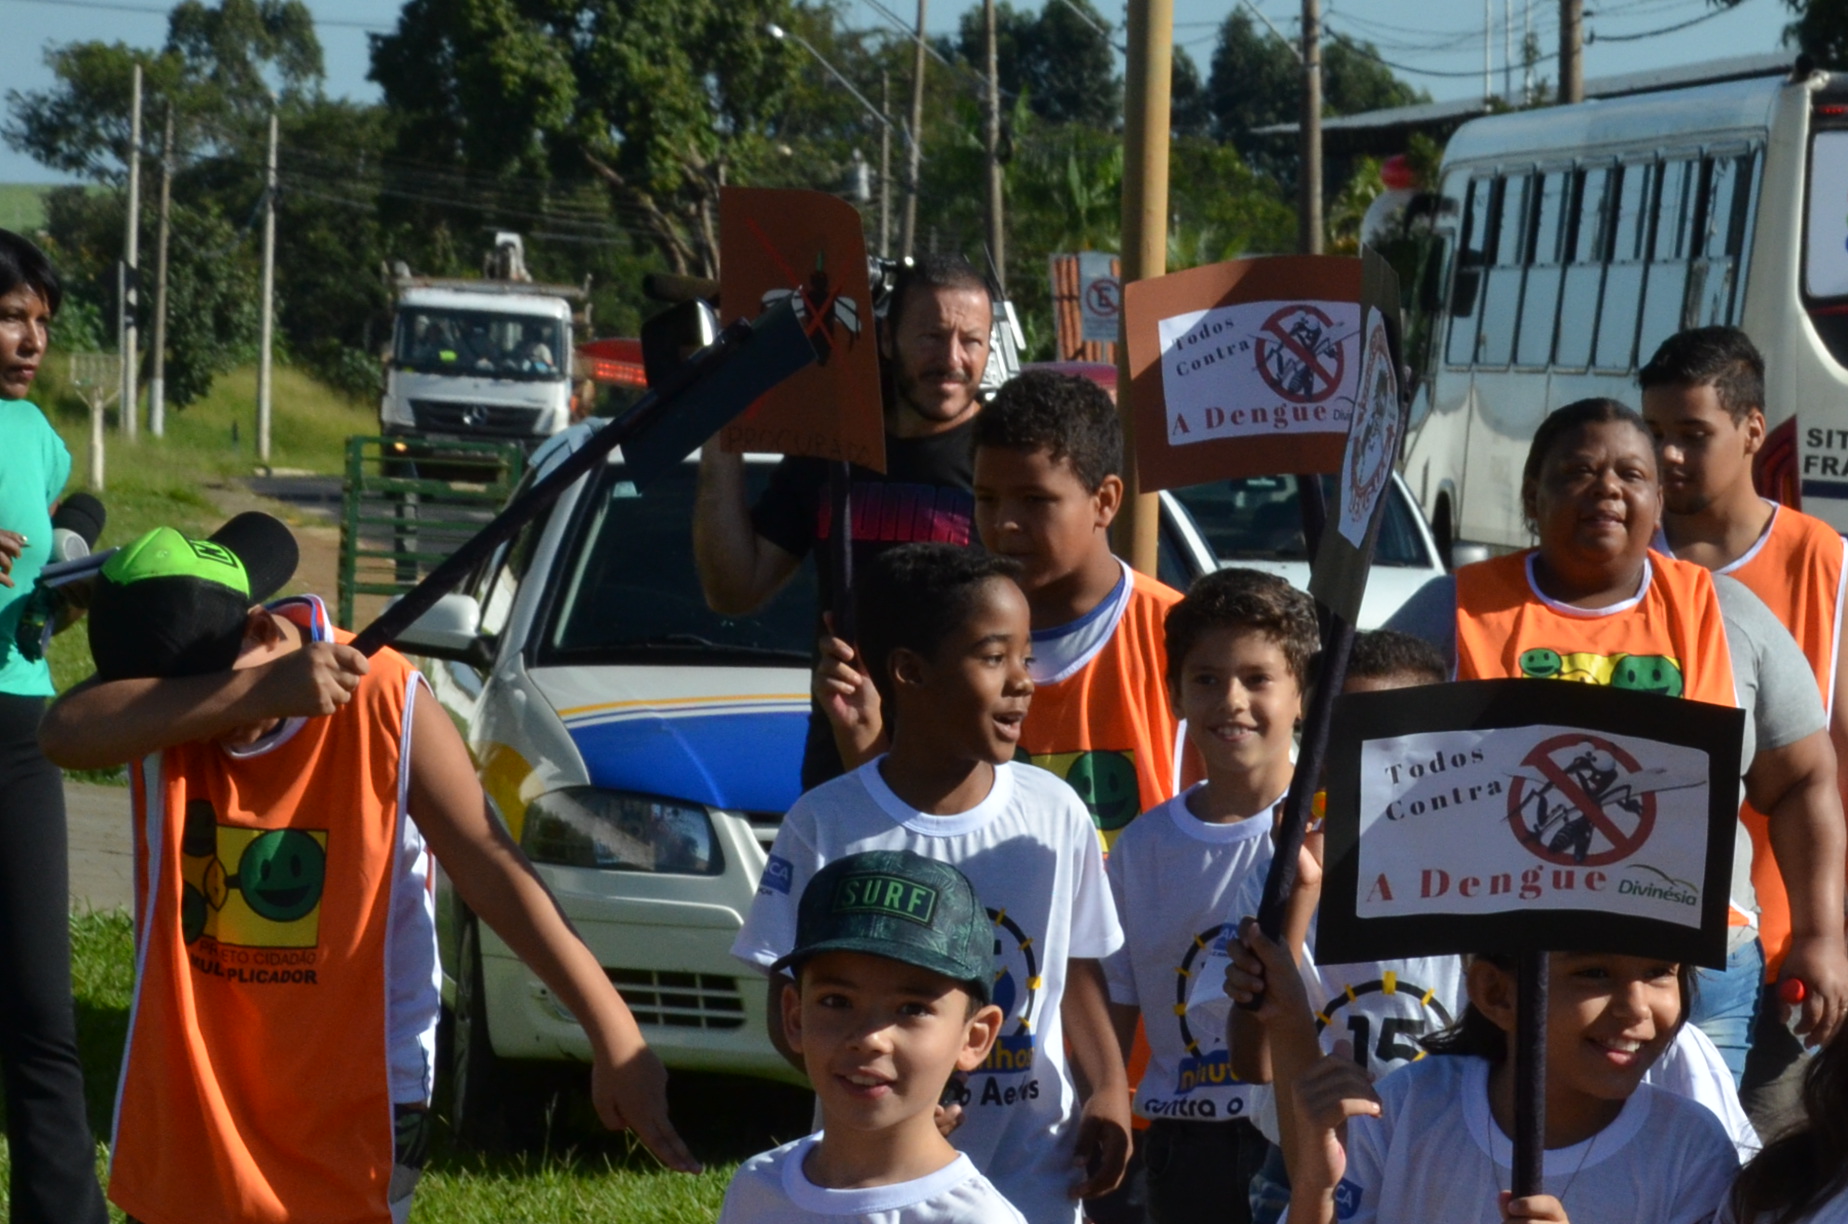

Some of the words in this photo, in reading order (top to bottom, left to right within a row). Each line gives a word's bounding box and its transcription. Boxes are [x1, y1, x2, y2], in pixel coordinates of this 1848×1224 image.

[1172, 317, 1235, 352] Todos
[1175, 337, 1252, 378] Contra
[1171, 412, 1192, 436] A
[1204, 402, 1328, 431] Dengue
[1384, 747, 1485, 786] Todos
[1385, 778, 1503, 822] Contra
[842, 879, 927, 913] SURF
[1366, 872, 1395, 902] A
[1420, 864, 1608, 900] Dengue
[1617, 878, 1698, 906] Divinésia
